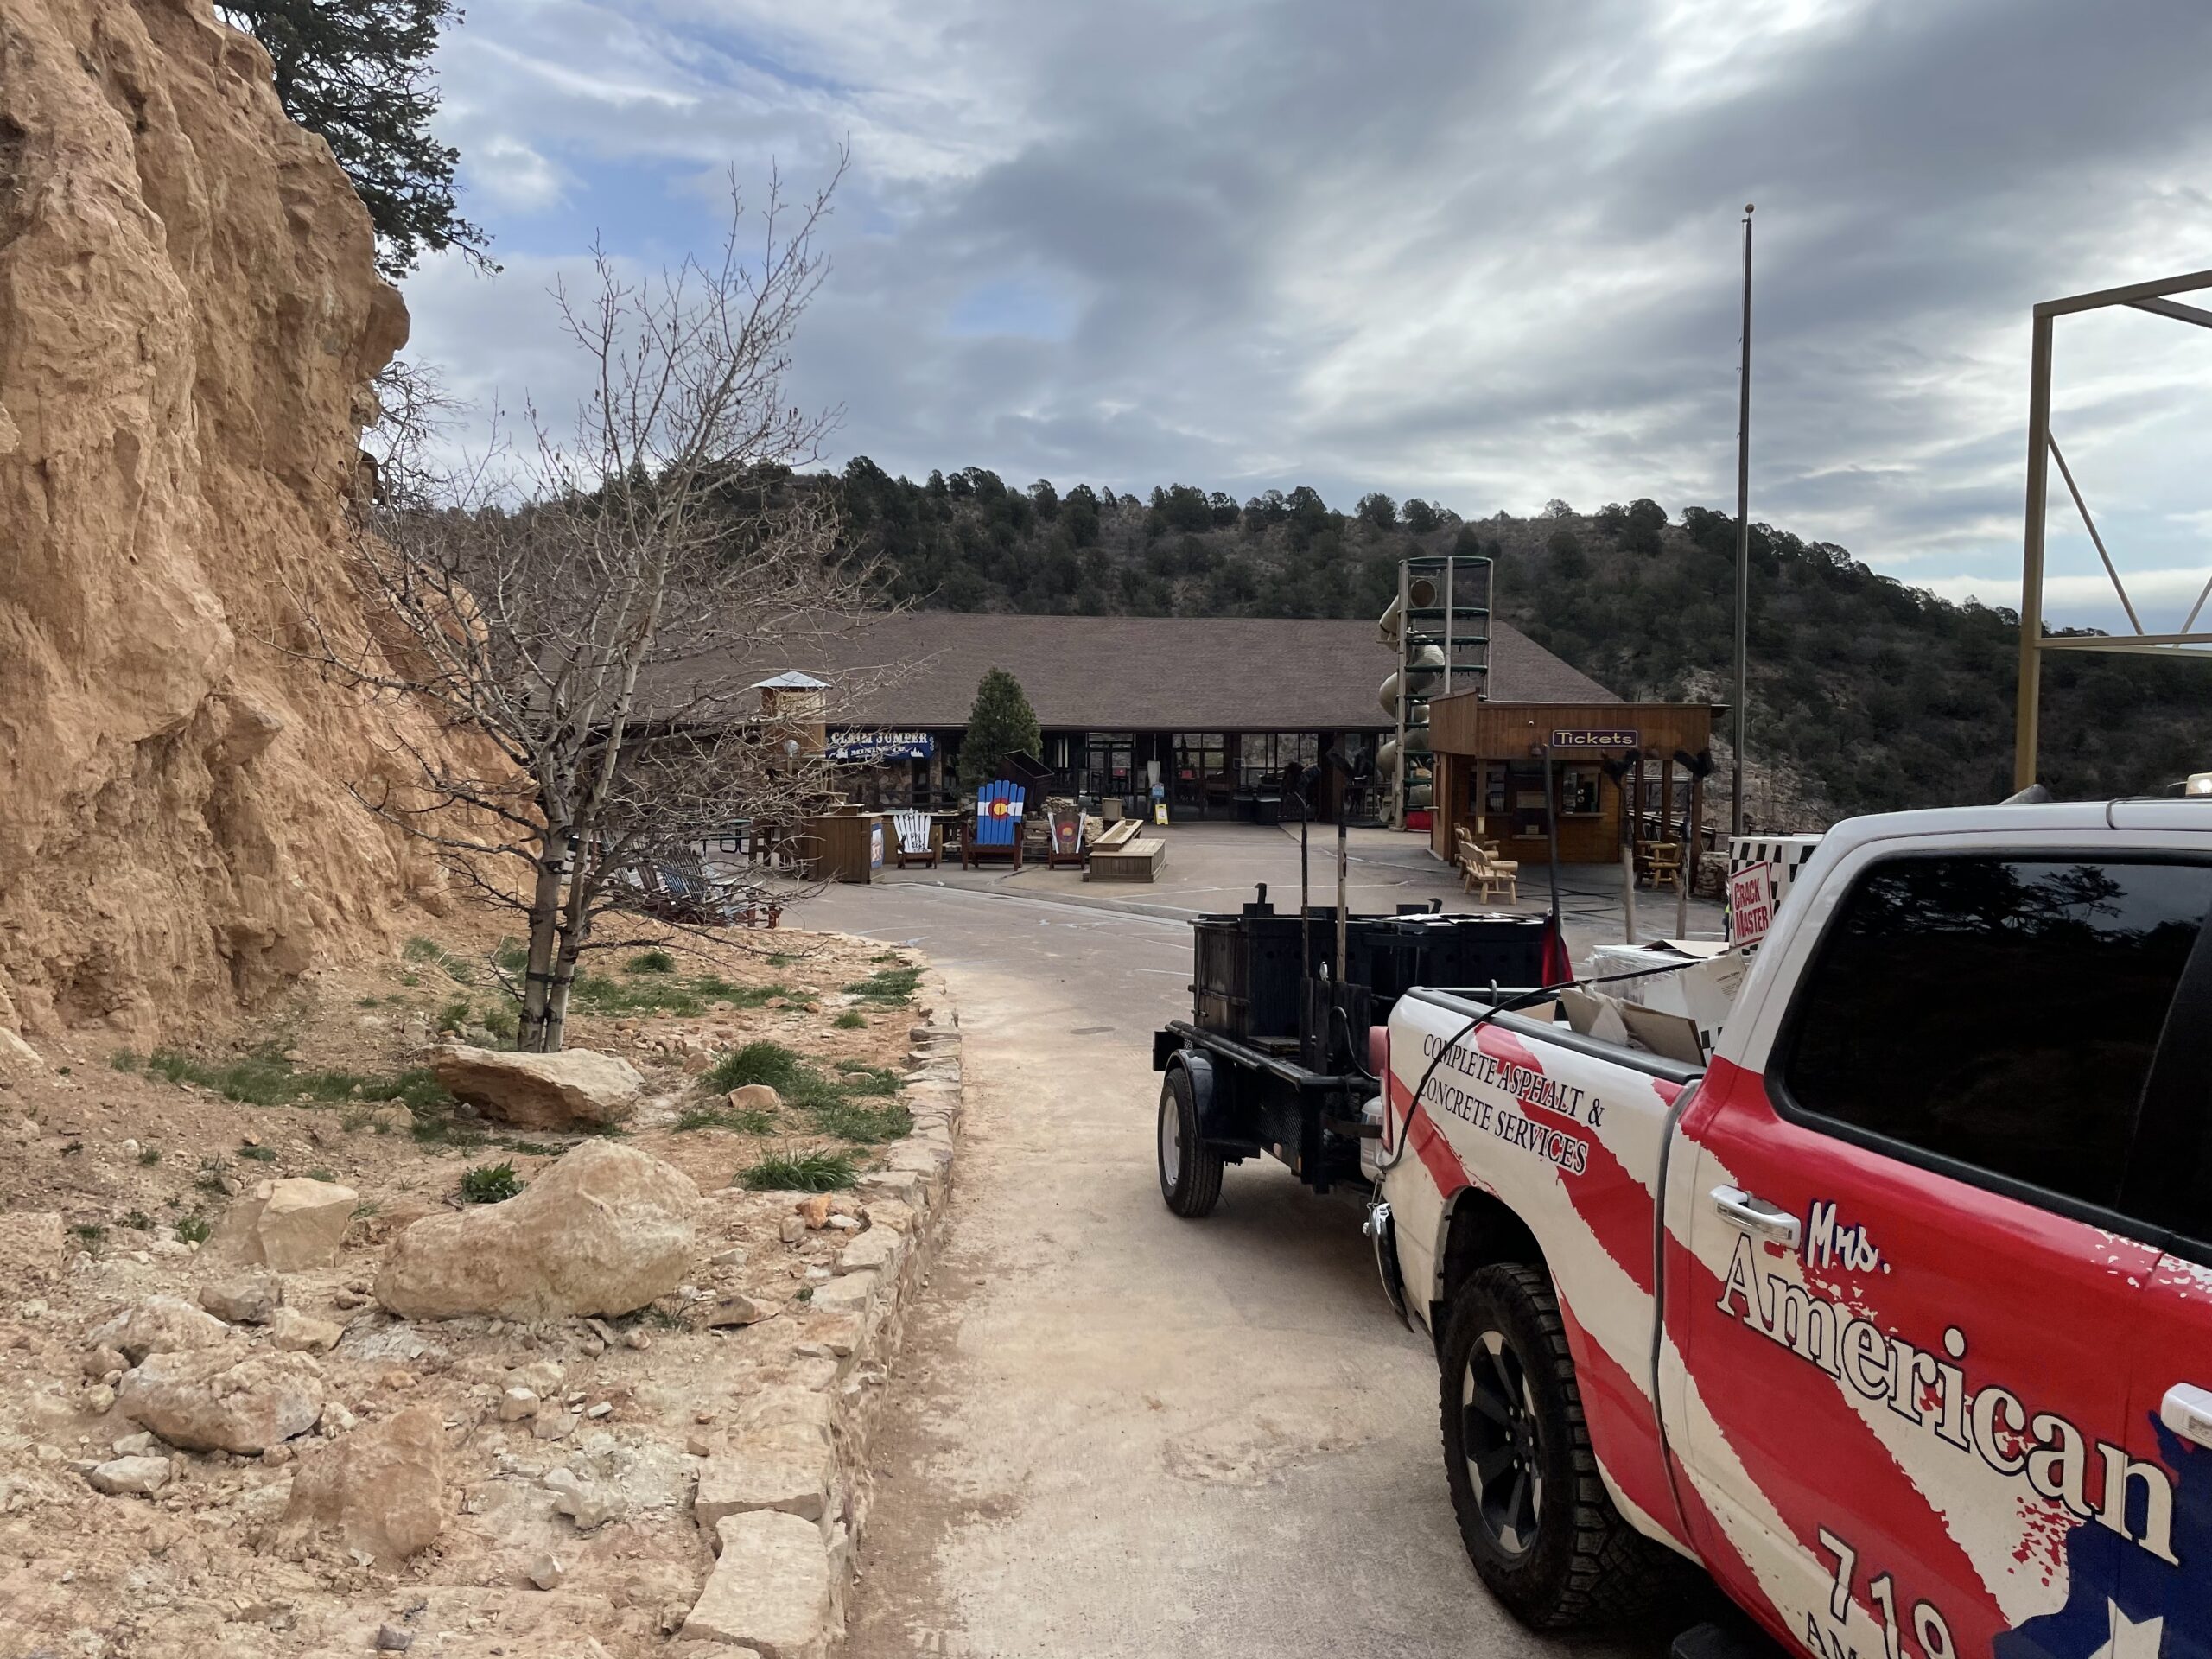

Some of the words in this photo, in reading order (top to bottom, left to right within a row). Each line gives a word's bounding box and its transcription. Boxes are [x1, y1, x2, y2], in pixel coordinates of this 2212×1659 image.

[831, 733, 873, 743] CLAIM
[876, 733, 928, 743] JUMPER
[1556, 732, 1633, 744] Tickets
[1734, 878, 1761, 911] CRACK
[1735, 906, 1769, 939] MASTER
[1423, 1033, 1498, 1085] COMPLETE
[1497, 1063, 1584, 1116] ASPHALT
[1587, 1098, 1605, 1127] &
[1494, 1110, 1587, 1174] SERVICES
[1807, 1199, 1891, 1274] Mrs.
[1716, 1232, 2179, 1567] American
